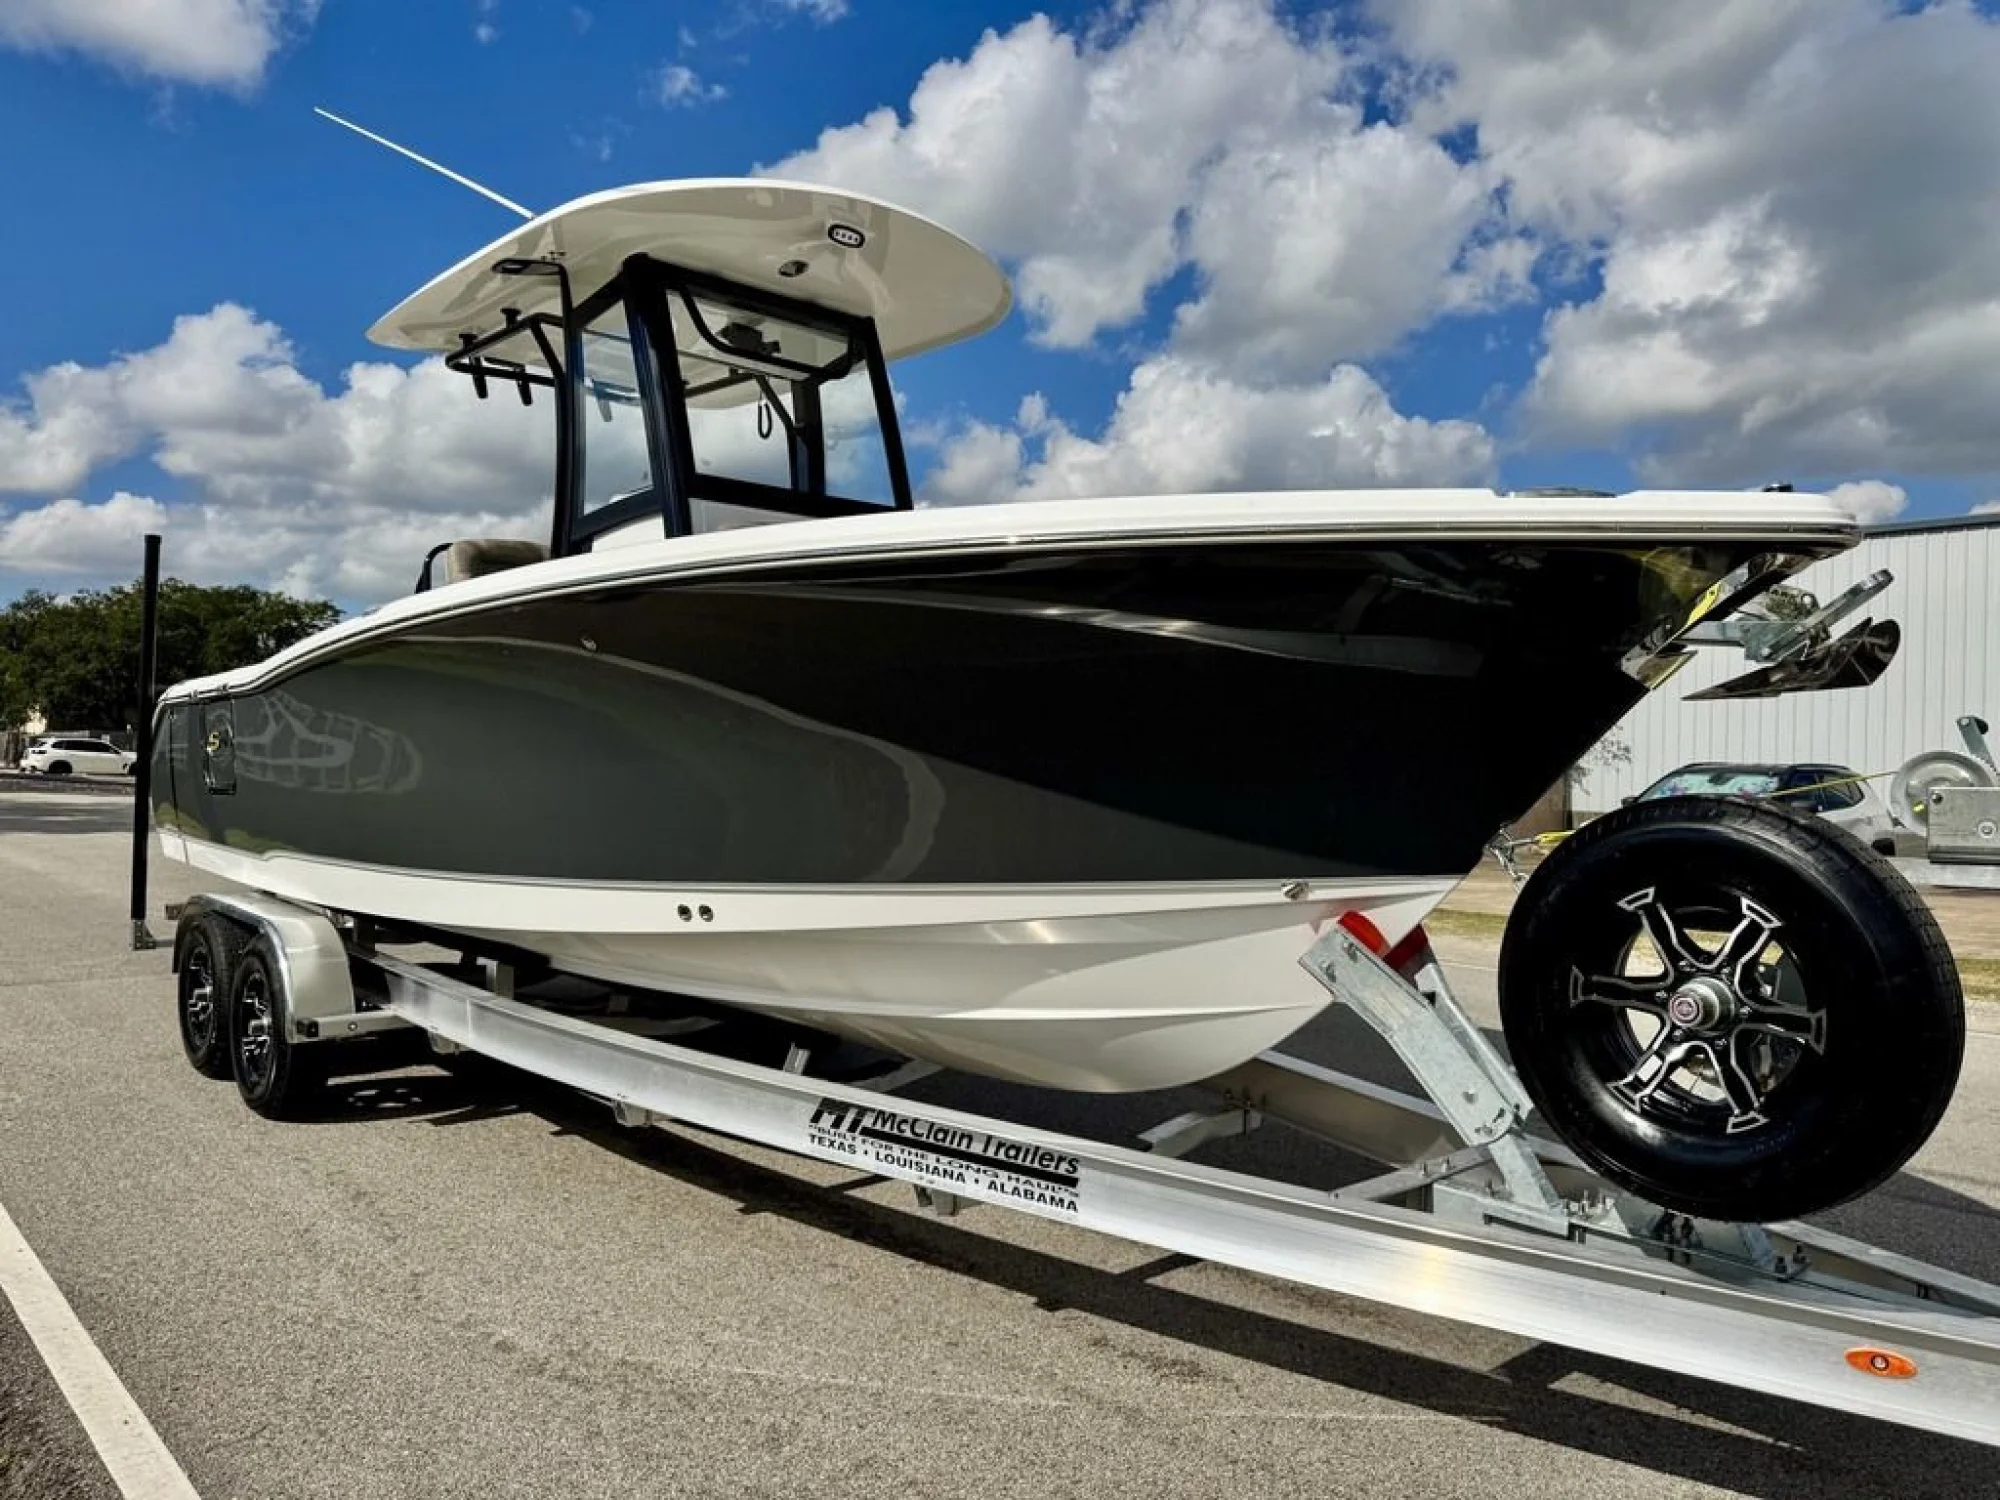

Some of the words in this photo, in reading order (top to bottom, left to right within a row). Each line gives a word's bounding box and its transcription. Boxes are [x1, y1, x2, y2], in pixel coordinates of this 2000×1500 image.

[809, 1133, 857, 1155] TEXAS
[875, 1150, 967, 1184] LOUISIANA
[987, 1180, 1079, 1213] ALABAMA
[873, 1109, 973, 1149] McClain
[981, 1134, 1079, 1175] Trailers
